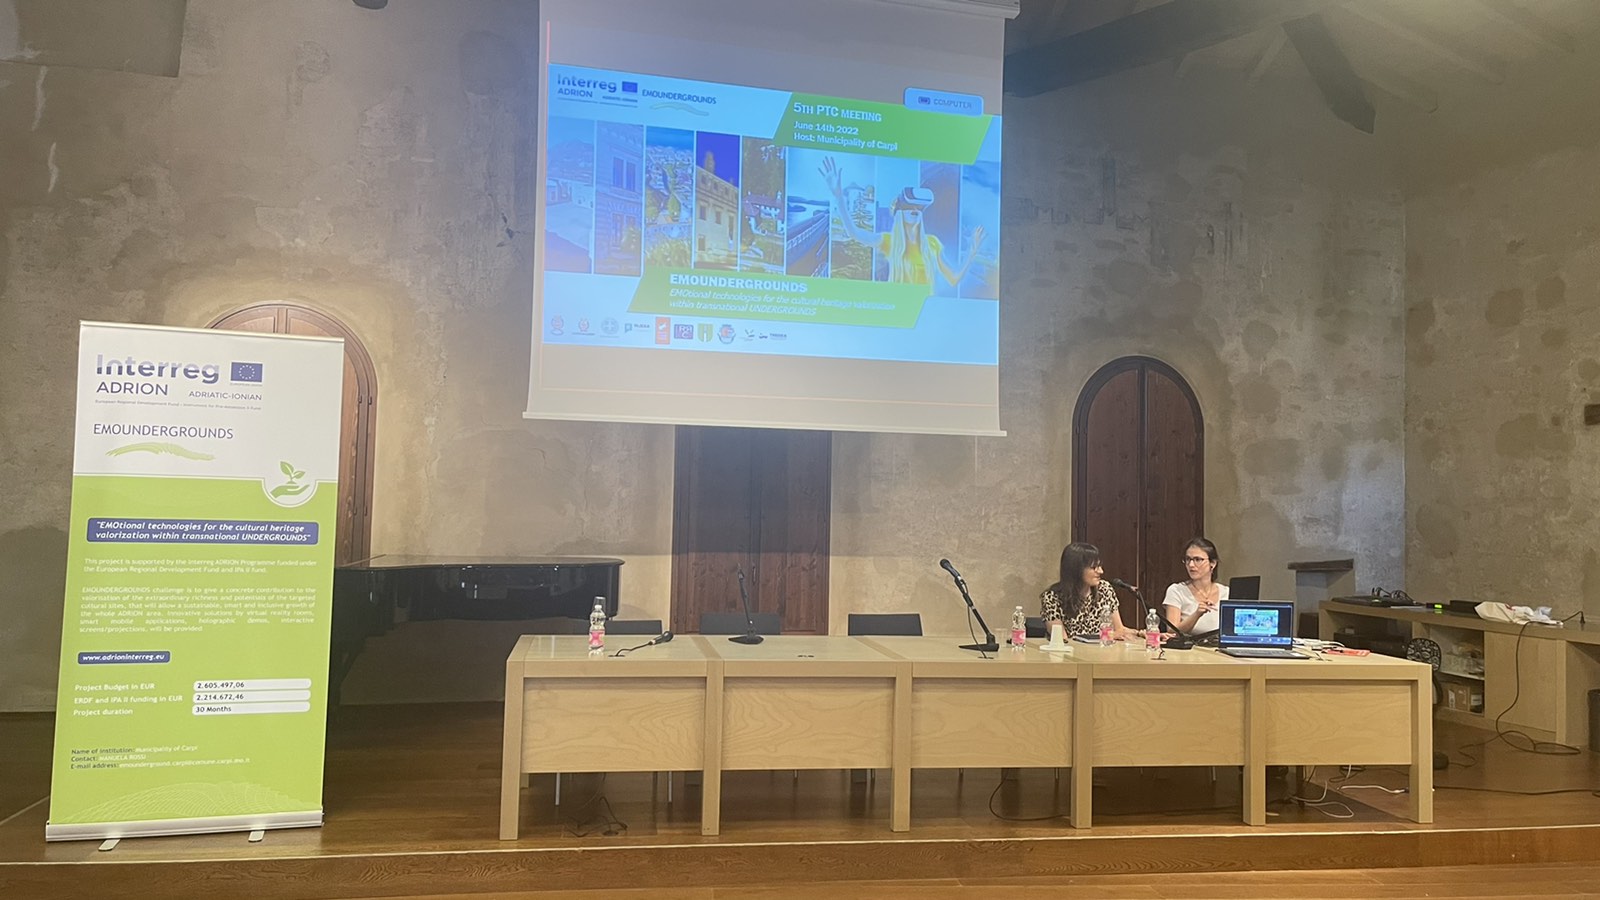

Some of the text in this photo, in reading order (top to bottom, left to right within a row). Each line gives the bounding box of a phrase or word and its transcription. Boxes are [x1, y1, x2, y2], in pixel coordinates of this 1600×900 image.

[557, 73, 617, 93] Interreg
[557, 88, 593, 98] ADRION
[642, 88, 717, 105] EMOUNDERGROUNDS
[933, 98, 973, 109] COMPUTER
[816, 105, 839, 117] PTC
[841, 109, 882, 122] MEETING
[794, 121, 859, 136] June 14th 2022
[794, 132, 898, 151] Host: Municipality of Carpi
[669, 273, 808, 293] EMOUNDERGROUNDS
[670, 288, 711, 299] EMOtional
[712, 291, 762, 304] technologies
[763, 294, 775, 303] for
[776, 295, 789, 304] the
[670, 300, 817, 316] within transnational UNDERGROUNDS
[96, 354, 220, 384] Interreg
[96, 381, 169, 396] ADRION
[188, 391, 263, 401] ADRIATIC-IONIAN
[93, 423, 234, 439] EMOUNDERGROUNDS
[147, 522, 202, 531] technologies
[203, 523, 217, 532] for
[235, 524, 268, 532] cultural
[270, 525, 305, 533] heritage
[96, 531, 150, 539] valorization
[152, 532, 180, 540] within
[182, 532, 240, 541] transnational
[98, 558, 124, 567] project
[132, 559, 165, 567] supported
[166, 559, 174, 567] by
[240, 560, 276, 568] Programme
[96, 567, 128, 576] European
[129, 567, 158, 576] Regional
[159, 567, 202, 576] Development
[82, 586, 151, 594] EMOUNDERGROUNDS
[145, 595, 190, 603] extraordinary
[82, 653, 165, 662] www.adrioninterreg.eu
[74, 684, 102, 692] Project
[103, 684, 130, 692] Budget
[197, 681, 245, 689] 2.605.497,06
[130, 696, 158, 704] funding
[196, 693, 245, 701] 2.214.672,46
[73, 709, 101, 717] Project
[206, 705, 232, 713] Months
